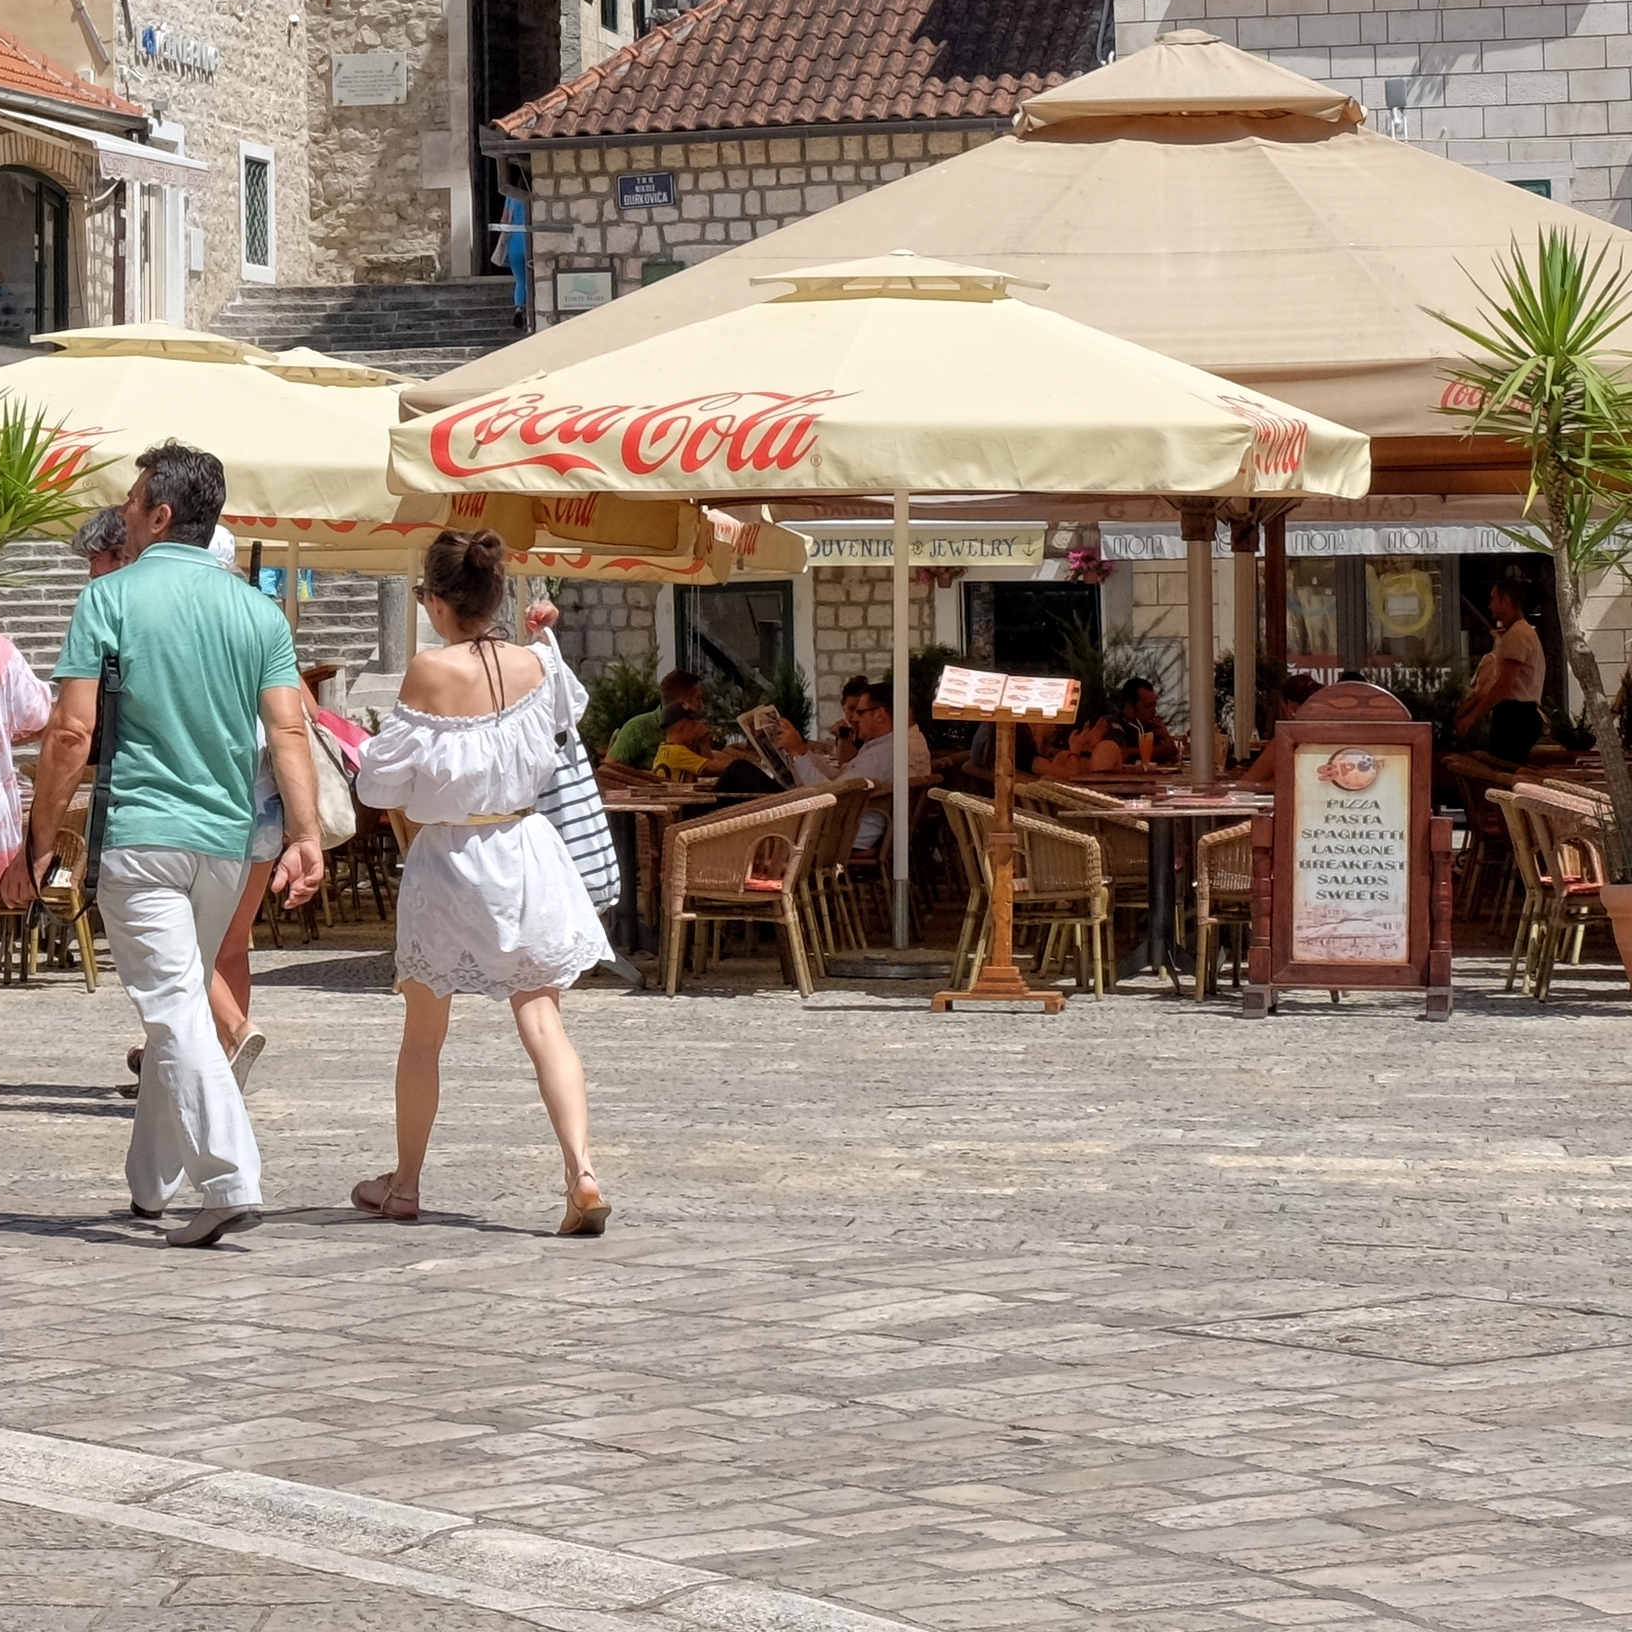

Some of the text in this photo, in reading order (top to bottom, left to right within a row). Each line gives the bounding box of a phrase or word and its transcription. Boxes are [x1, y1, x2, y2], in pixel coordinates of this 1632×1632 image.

[810, 535, 1019, 558] OUVENIR JEWELRY
[1325, 799, 1381, 810] PIZZA
[1324, 814, 1383, 825] PASTA
[1300, 828, 1405, 840] SPAGHETTI
[1311, 844, 1395, 855] LASAGNE
[1298, 859, 1406, 871] BREAKFAST
[1317, 874, 1389, 886] SALADS
[1315, 889, 1390, 902] SWEETS
